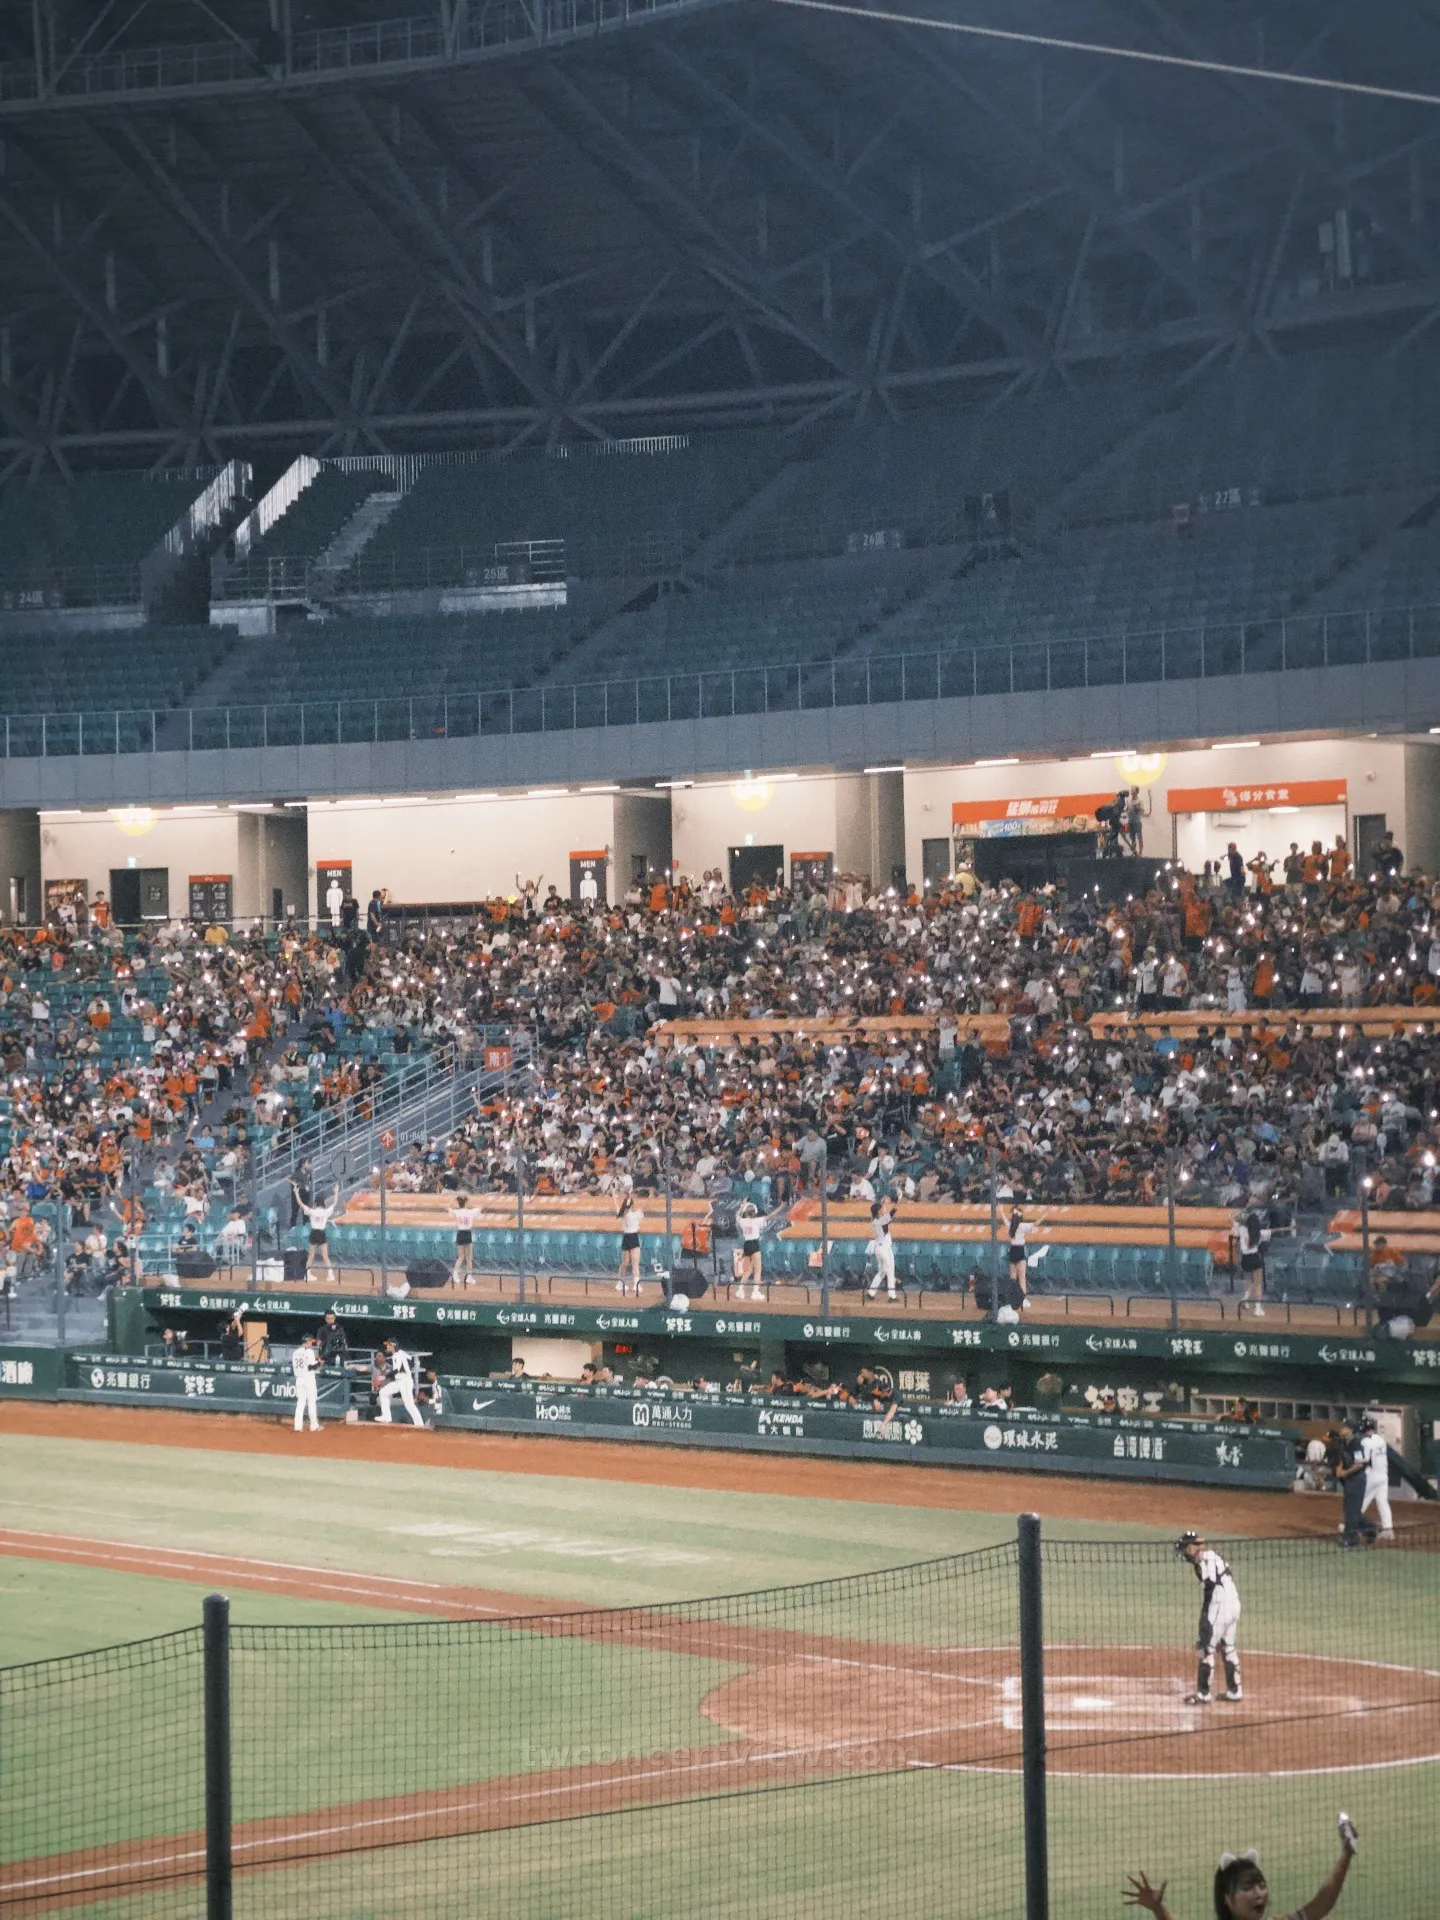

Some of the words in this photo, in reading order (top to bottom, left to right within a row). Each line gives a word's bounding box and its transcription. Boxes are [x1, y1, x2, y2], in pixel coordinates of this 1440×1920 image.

[580, 860, 596, 869] MEN
[326, 869, 342, 878] MEN
[106, 1371, 151, 1389] 兆豐銀行
[271, 1381, 297, 1398] unio
[651, 1405, 692, 1421] 萬通人力
[773, 1413, 804, 1425] KENDA
[1003, 1429, 1059, 1450] 環球水泥
